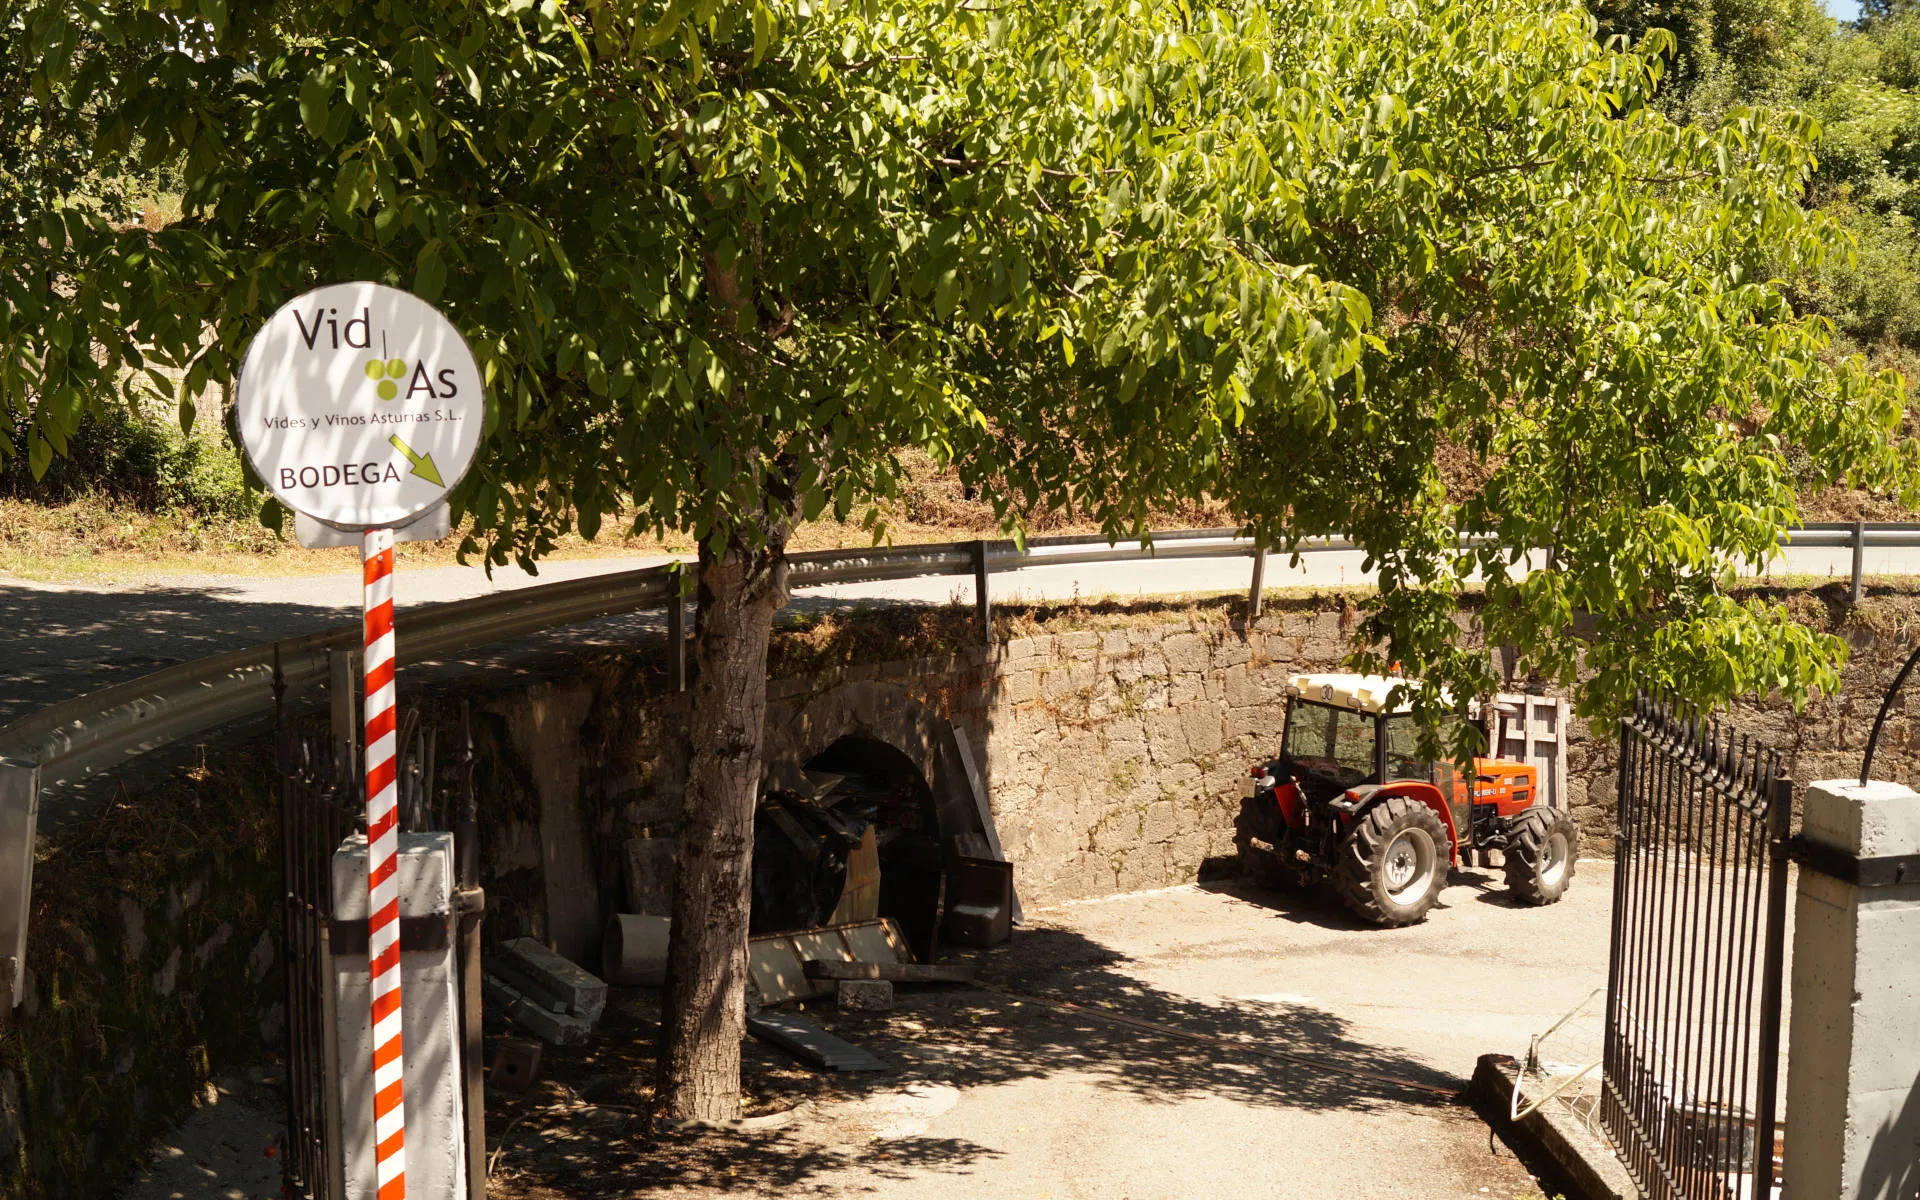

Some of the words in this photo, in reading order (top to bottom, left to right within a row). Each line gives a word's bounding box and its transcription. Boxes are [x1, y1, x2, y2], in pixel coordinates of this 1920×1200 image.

[293, 307, 371, 350] Vid
[405, 359, 458, 400] As
[264, 416, 306, 429] Vides
[310, 418, 320, 429] y
[325, 414, 366, 426] Vinos
[370, 412, 430, 424] Asturias
[435, 410, 462, 422] S.L.
[280, 462, 401, 489] BODEGA
